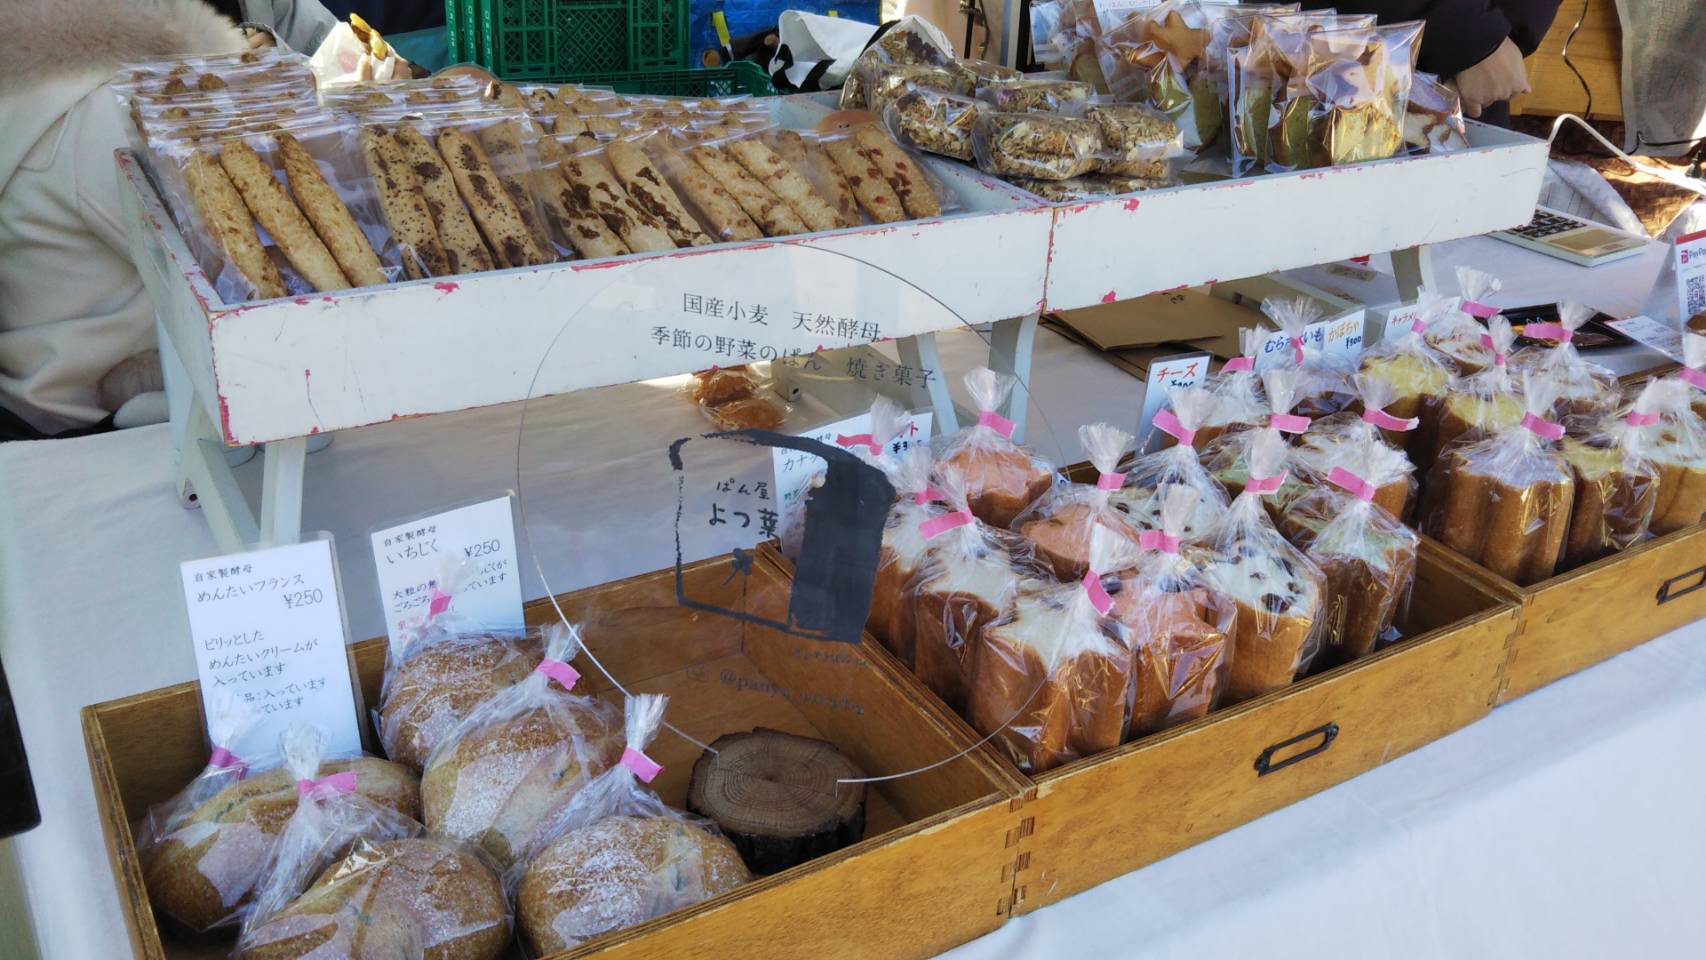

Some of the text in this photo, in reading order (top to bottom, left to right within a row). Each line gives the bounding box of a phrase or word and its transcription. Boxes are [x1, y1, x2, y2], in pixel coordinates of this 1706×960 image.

[682, 292, 882, 342] 国産小麦 天然酵母
[1264, 327, 1323, 353] むらいも
[650, 325, 937, 389] 季節の野菜のぱん 焼き菓子
[1156, 360, 1200, 384] チーズ
[716, 477, 771, 500] ぱん屋
[383, 525, 437, 547] 自家製酵母
[463, 539, 501, 558] ¥250
[386, 539, 440, 564] いちじく
[194, 563, 253, 583] 自家製酵母
[197, 573, 305, 602] めんたいフランス
[282, 588, 324, 609] ¥250
[208, 638, 319, 671] めんたいクリームが
[213, 662, 286, 688] 入っています
